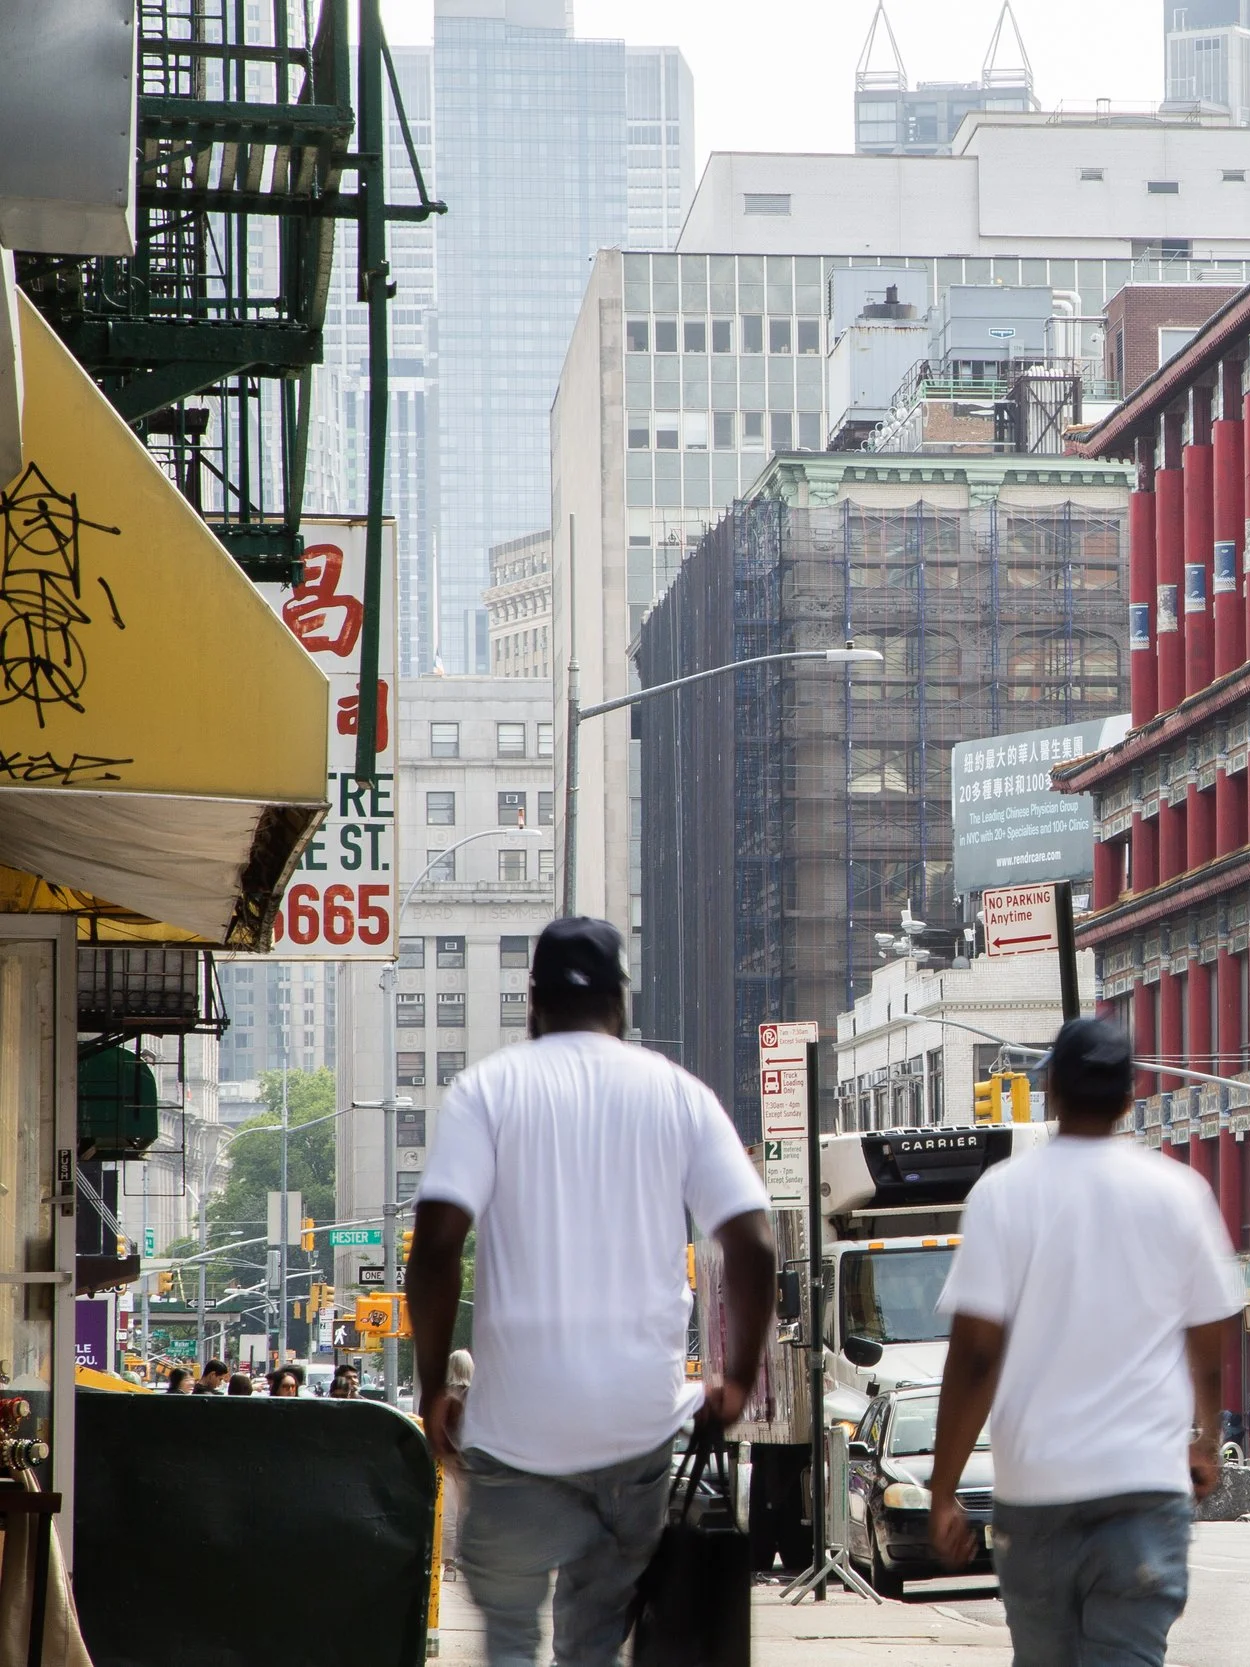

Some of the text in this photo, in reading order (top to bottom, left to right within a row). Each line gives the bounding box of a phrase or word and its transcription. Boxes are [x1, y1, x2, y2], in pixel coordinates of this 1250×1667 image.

[969, 800, 1079, 825] The Leading Chinese Physician Group
[959, 818, 1090, 846] in NYC with 20+ Specialties and 100+ Clinics
[996, 850, 1061, 867] www.rendrcare.com
[988, 891, 1051, 909] NO PARKING
[412, 906, 454, 920] BARD
[990, 911, 1033, 925] Anytime
[783, 1079, 804, 1087] Loading
[783, 1087, 796, 1095] Only
[789, 1101, 800, 1109] 4pm
[783, 1110, 802, 1118] Sunday
[768, 1141, 779, 1159] 2
[901, 1136, 977, 1151] CARRIER
[783, 1152, 800, 1160] parking
[60, 1150, 69, 1180] PUSH
[783, 1167, 794, 1175] 7pm
[785, 1176, 803, 1184] Sunday
[332, 1231, 369, 1244] HESTER
[365, 1272, 382, 1280] ONE
[75, 1355, 98, 1365] OU.
